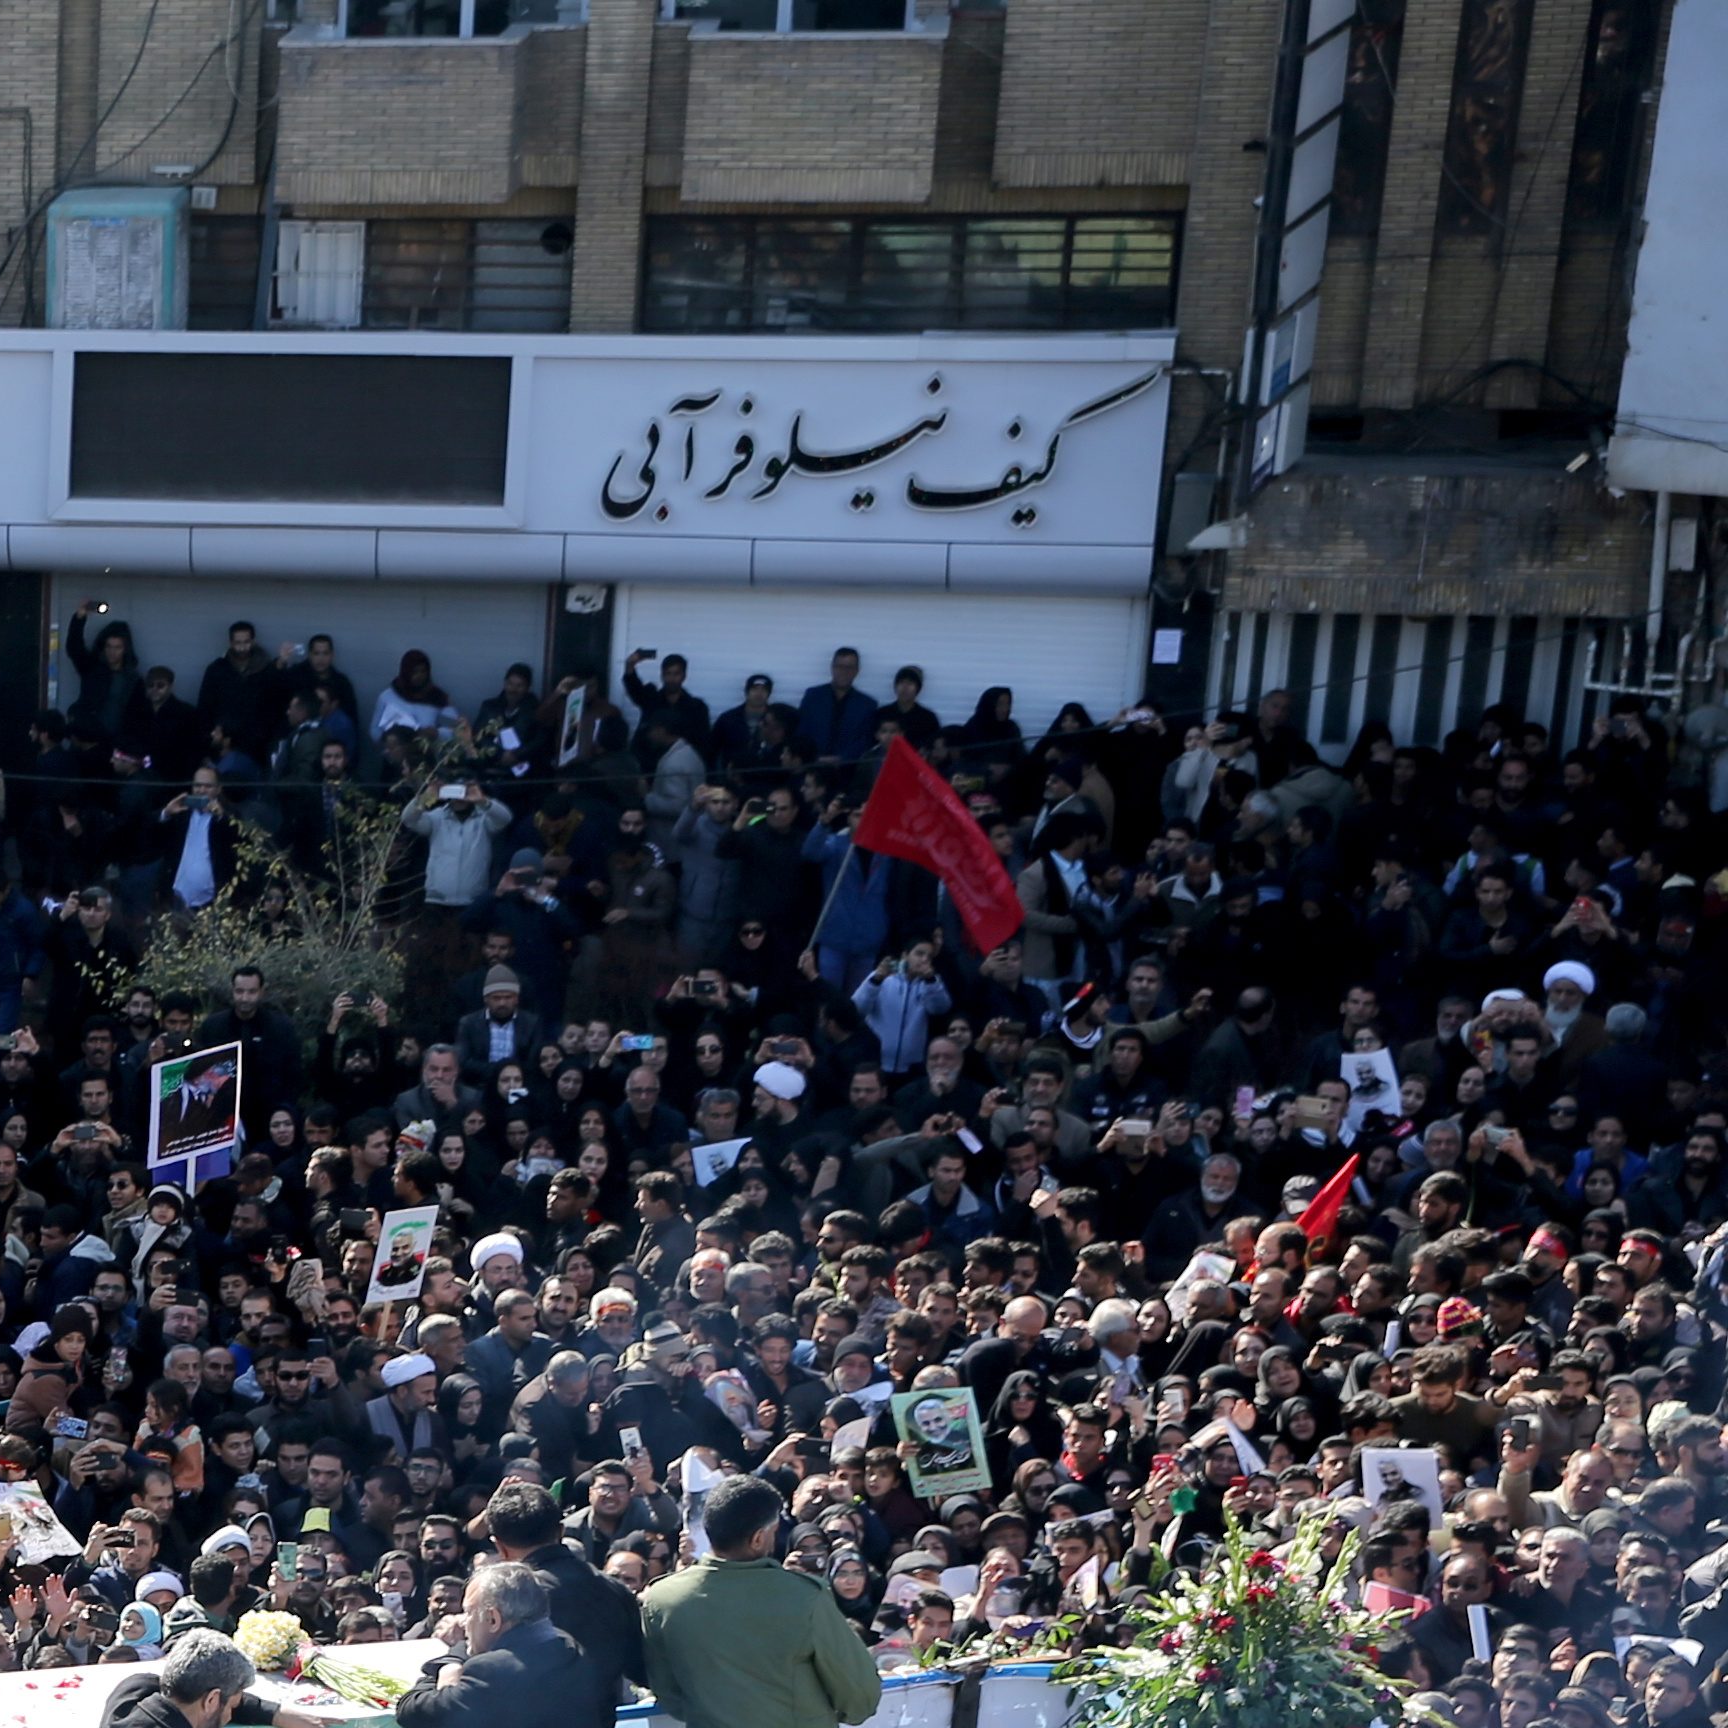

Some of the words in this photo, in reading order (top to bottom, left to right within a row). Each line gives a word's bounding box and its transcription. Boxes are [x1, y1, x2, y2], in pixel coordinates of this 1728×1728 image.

[599, 390, 724, 525] آبی
[705, 372, 951, 513] نیلوفر
[905, 365, 1168, 529] کیف
